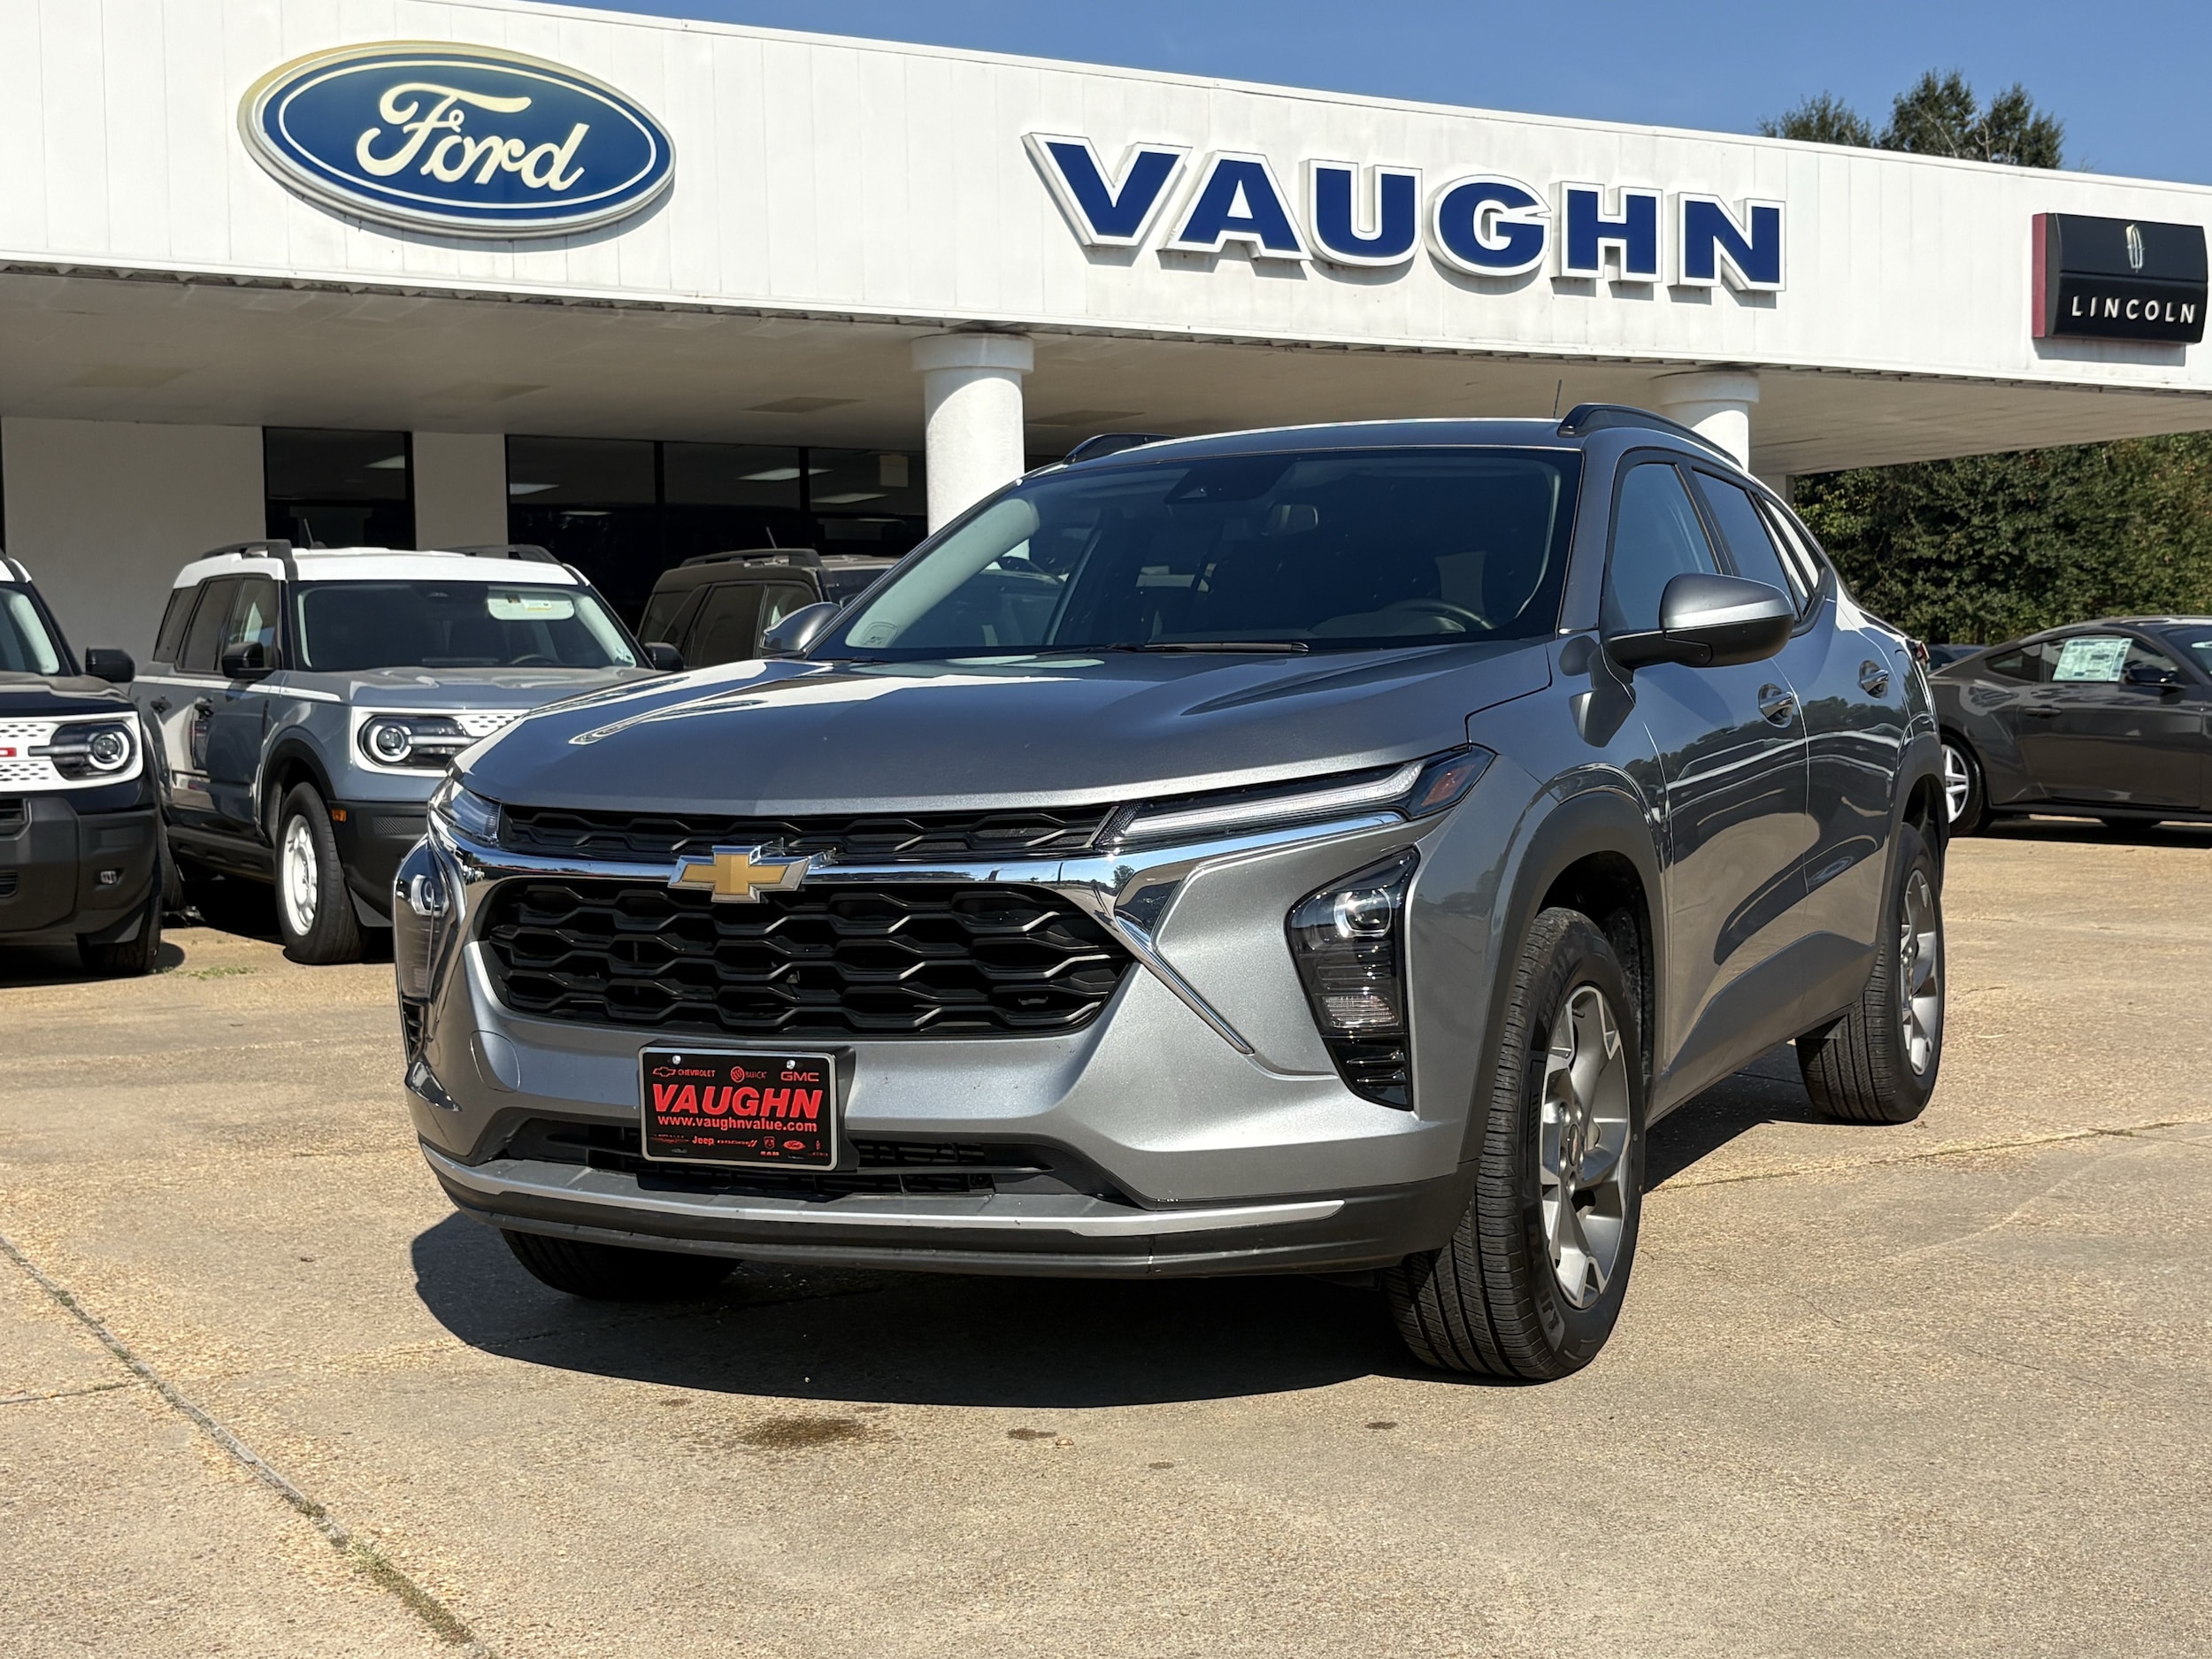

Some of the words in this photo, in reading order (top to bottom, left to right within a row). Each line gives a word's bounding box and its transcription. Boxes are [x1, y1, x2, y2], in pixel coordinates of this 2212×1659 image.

[357, 82, 590, 191] Ford
[1025, 133, 1786, 291] VAUGHN
[2071, 296, 2196, 324] LINCOLN
[678, 1068, 716, 1078] CHEVROLET
[780, 1071, 819, 1082] GMC
[652, 1084, 823, 1118] VAUGHN
[657, 1115, 818, 1133] www.vaughnvalue.com
[692, 1135, 715, 1146] Jeep
